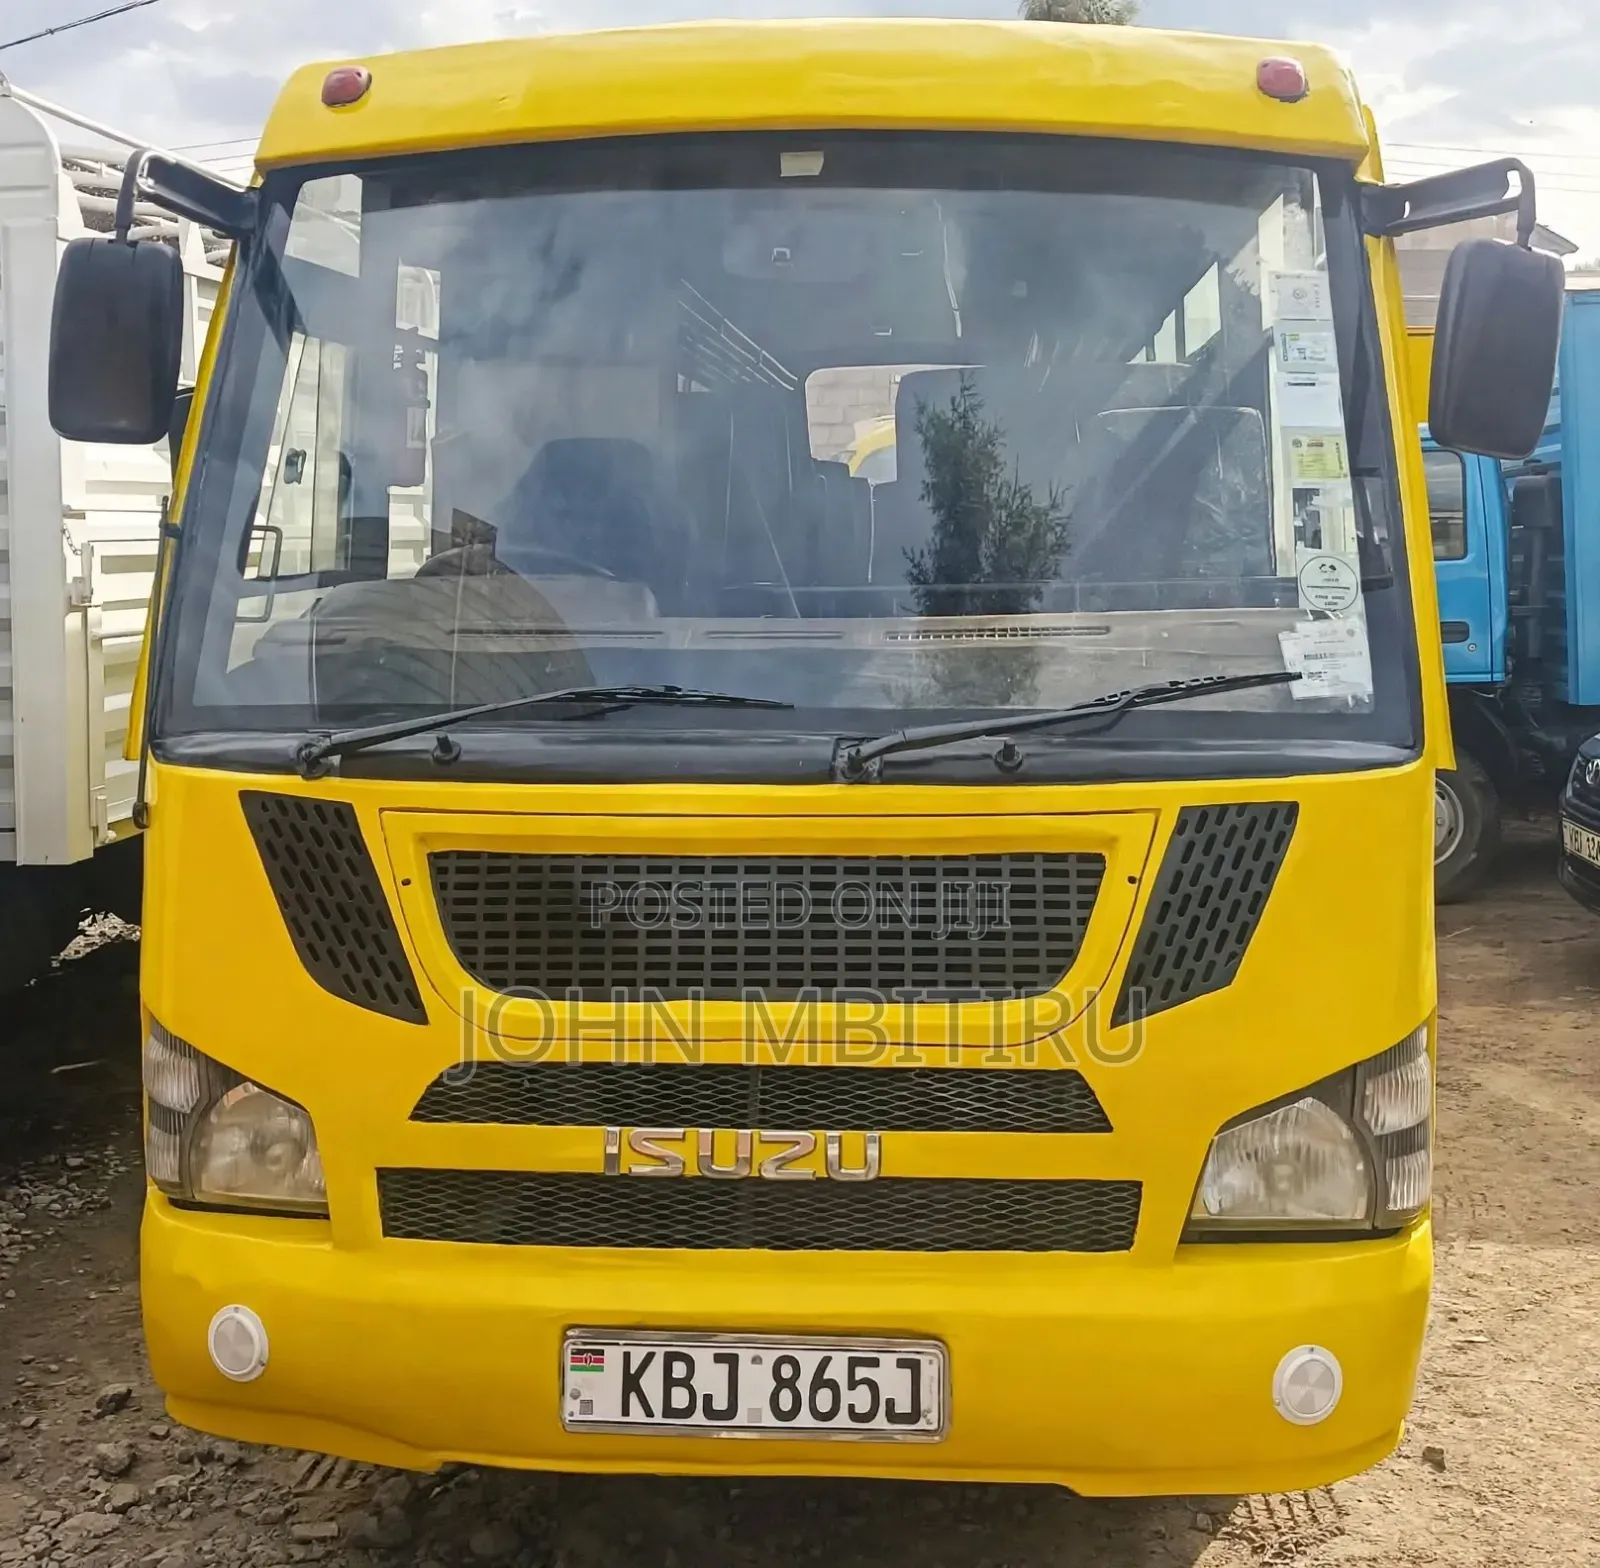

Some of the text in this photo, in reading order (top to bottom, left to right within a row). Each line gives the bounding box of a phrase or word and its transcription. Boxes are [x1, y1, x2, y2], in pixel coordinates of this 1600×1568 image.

[603, 1126, 881, 1181] ISUZU
[621, 1350, 922, 1425] KBJ 865J
